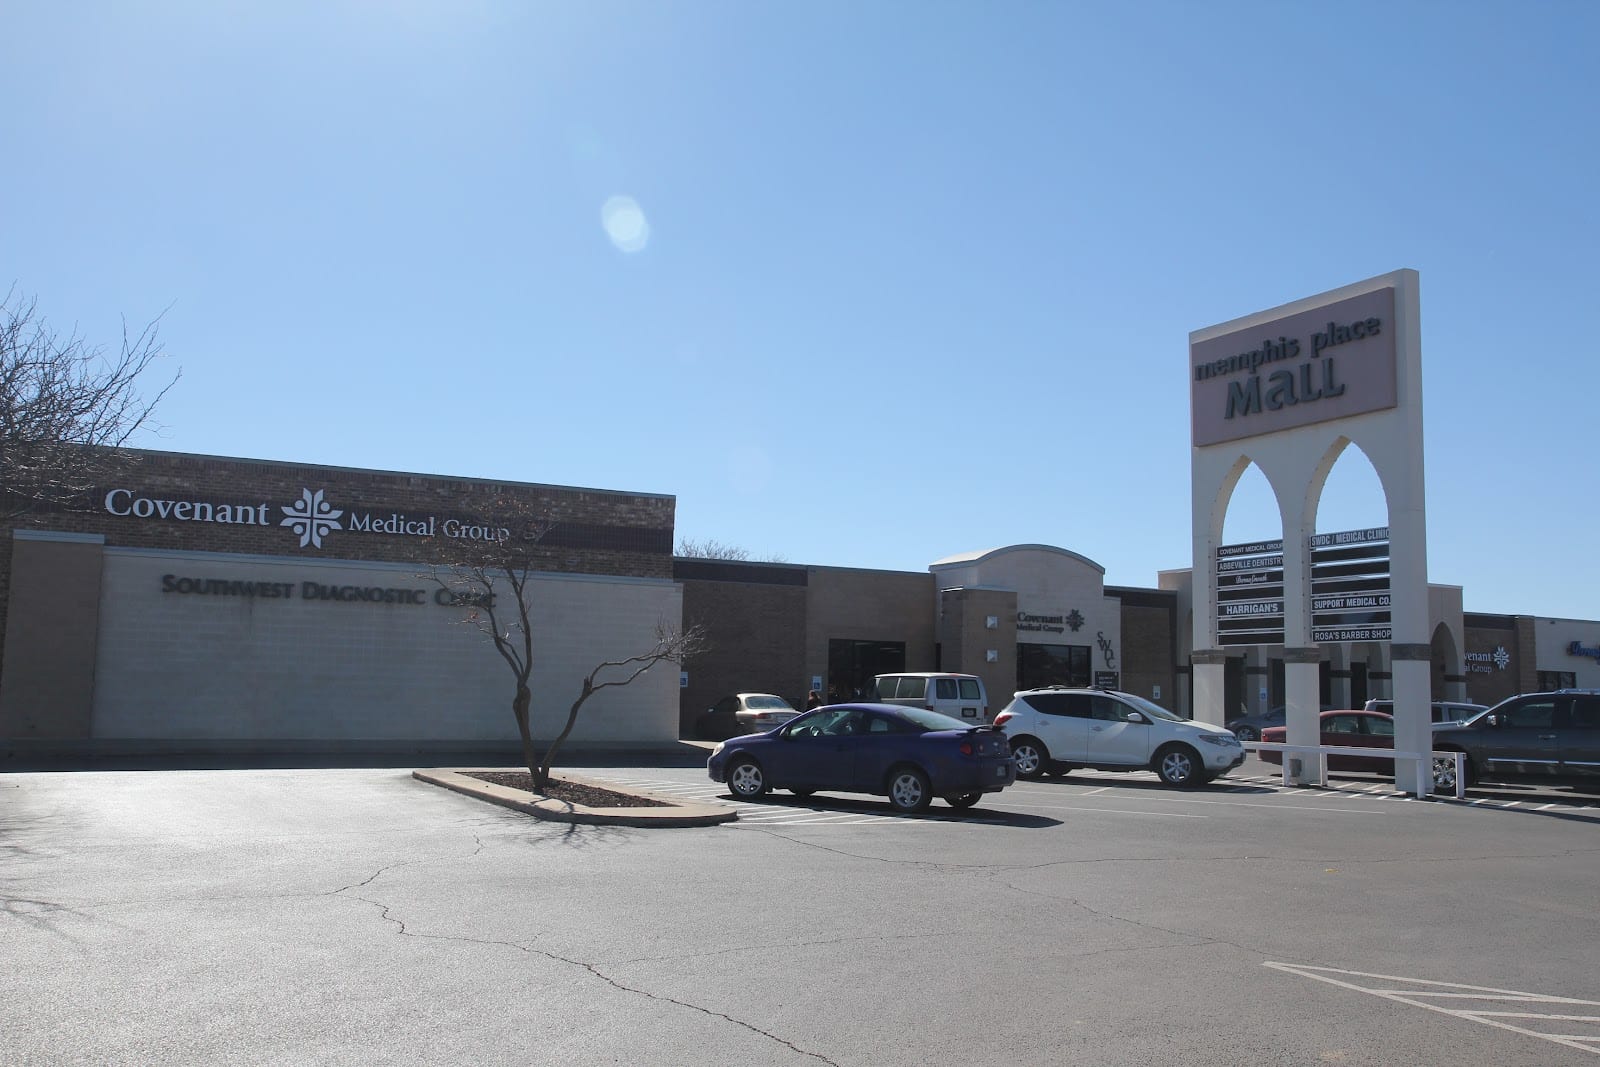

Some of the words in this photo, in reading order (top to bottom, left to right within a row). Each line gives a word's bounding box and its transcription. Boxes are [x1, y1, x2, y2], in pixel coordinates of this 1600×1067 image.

[1195, 336, 1300, 381] memphis
[1311, 316, 1381, 358] place
[104, 488, 269, 526] Covenant
[349, 512, 435, 537] Medical
[442, 519, 510, 545] Group
[1311, 534, 1331, 546] SWDC
[1336, 531, 1366, 544] MEDICAL
[1367, 528, 1390, 540] CLINIC
[1245, 544, 1265, 552] MEDICAL
[1219, 560, 1251, 571] ABBEVILLE
[162, 574, 295, 599] SOUTHWEST
[302, 581, 426, 605] DIAGNOSTIC
[1314, 599, 1345, 609] SUPPORT
[1346, 595, 1377, 607] MEDICAL
[1378, 596, 1391, 605] CO.
[1226, 603, 1279, 615] HARRIGAN'S
[1017, 611, 1063, 624] Covenant
[1314, 631, 1340, 641] ROSA'S
[1341, 630, 1370, 640] BARBER
[1371, 629, 1391, 639] SHOP
[1464, 651, 1492, 662] venant
[1472, 664, 1492, 675] Group
